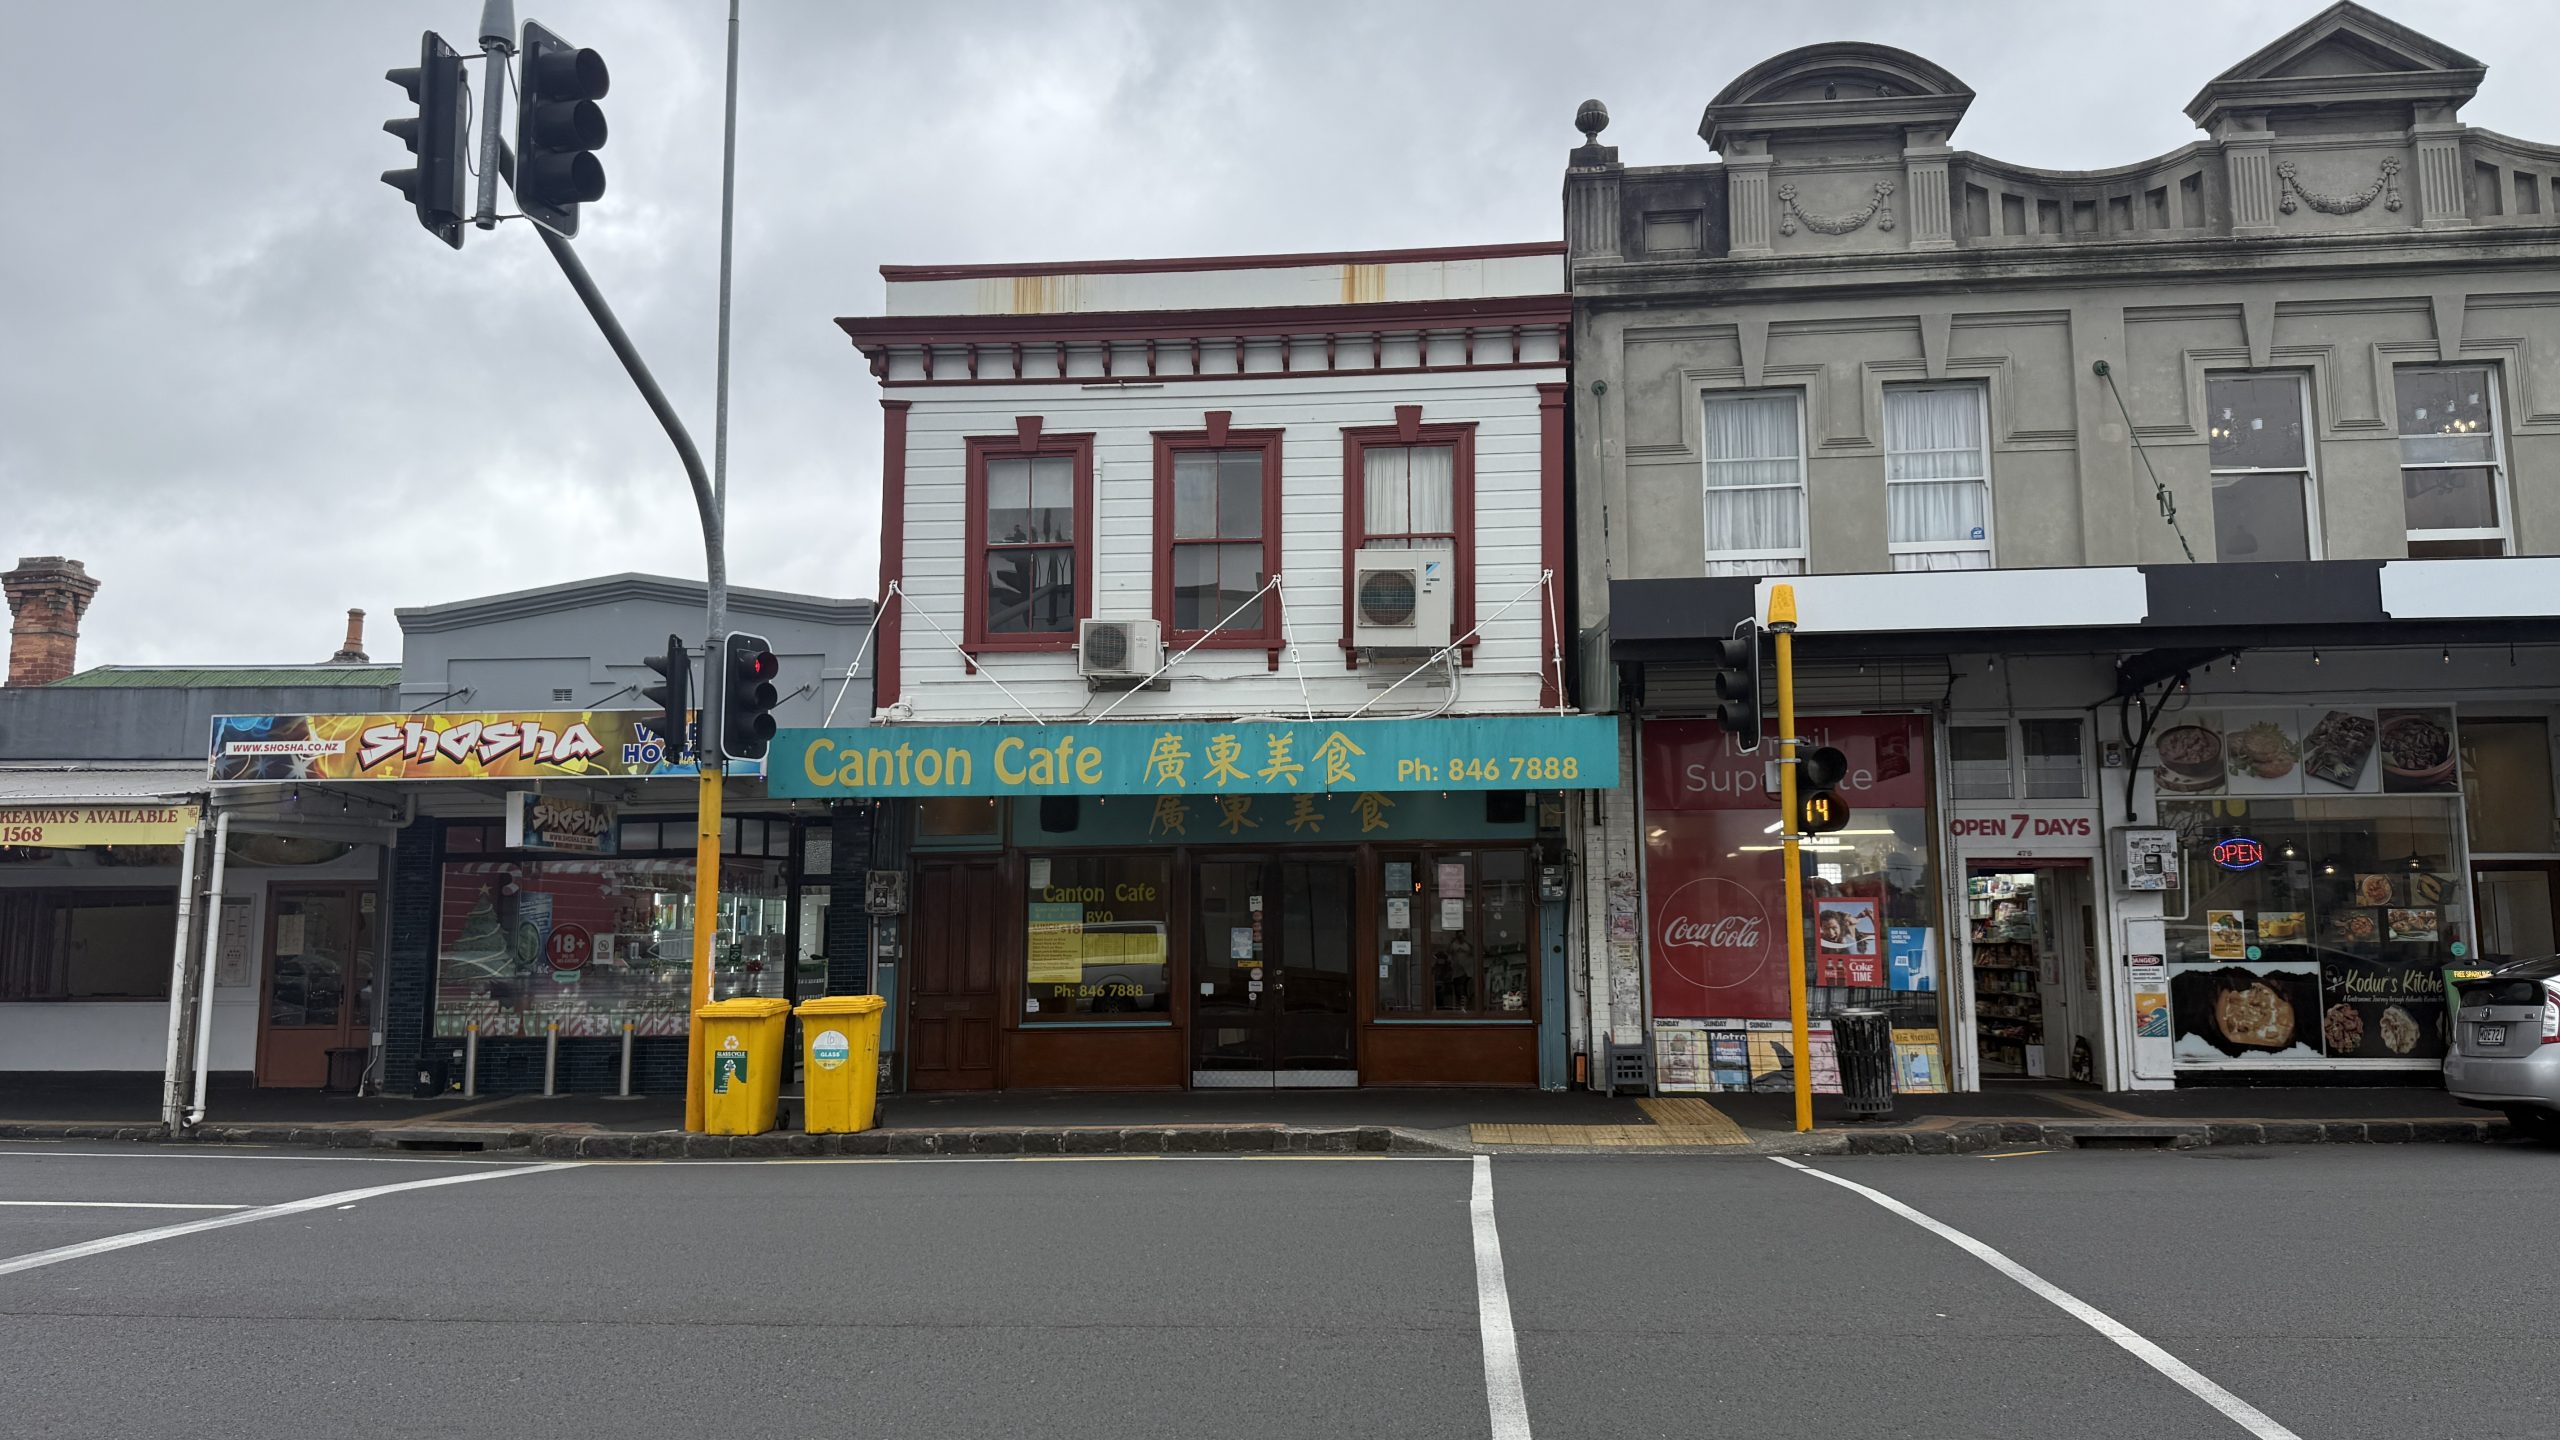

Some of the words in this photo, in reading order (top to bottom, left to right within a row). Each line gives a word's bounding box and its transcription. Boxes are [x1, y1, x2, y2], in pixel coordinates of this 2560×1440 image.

[232, 742, 338, 753] WWW.SHOSHA.CO.NZ
[804, 738, 972, 786] Canton
[994, 735, 1103, 785] Cafe
[1143, 730, 1366, 788] 廣東美食
[1398, 757, 1438, 782] Ph:
[1448, 758, 1500, 781] 846
[1509, 757, 1579, 780] 7888
[85, 809, 178, 823] AVAILABLE
[1148, 791, 1395, 836] 廣東美食
[1806, 799, 1829, 823] 14
[3, 826, 42, 842] 1568
[1950, 818, 2006, 836] OPEN
[2010, 814, 2030, 839] 7
[2034, 817, 2091, 836] DAYS
[2213, 844, 2263, 862] OPEN
[1043, 884, 1105, 902] Canton
[1115, 883, 1156, 902] Cafe
[1086, 911, 1113, 923] BYO
[1664, 916, 1764, 947] Coca-Cola
[554, 934, 585, 953] 18+
[1849, 962, 1874, 972] Coke
[1851, 971, 1872, 982] TIME
[2345, 968, 2397, 993] Kodur's
[2402, 969, 2443, 993] Kitche
[1054, 985, 1075, 998] Ph:
[1079, 985, 1105, 998] 846
[1109, 984, 1144, 997] 7888
[1710, 1032, 1746, 1041] Metro
